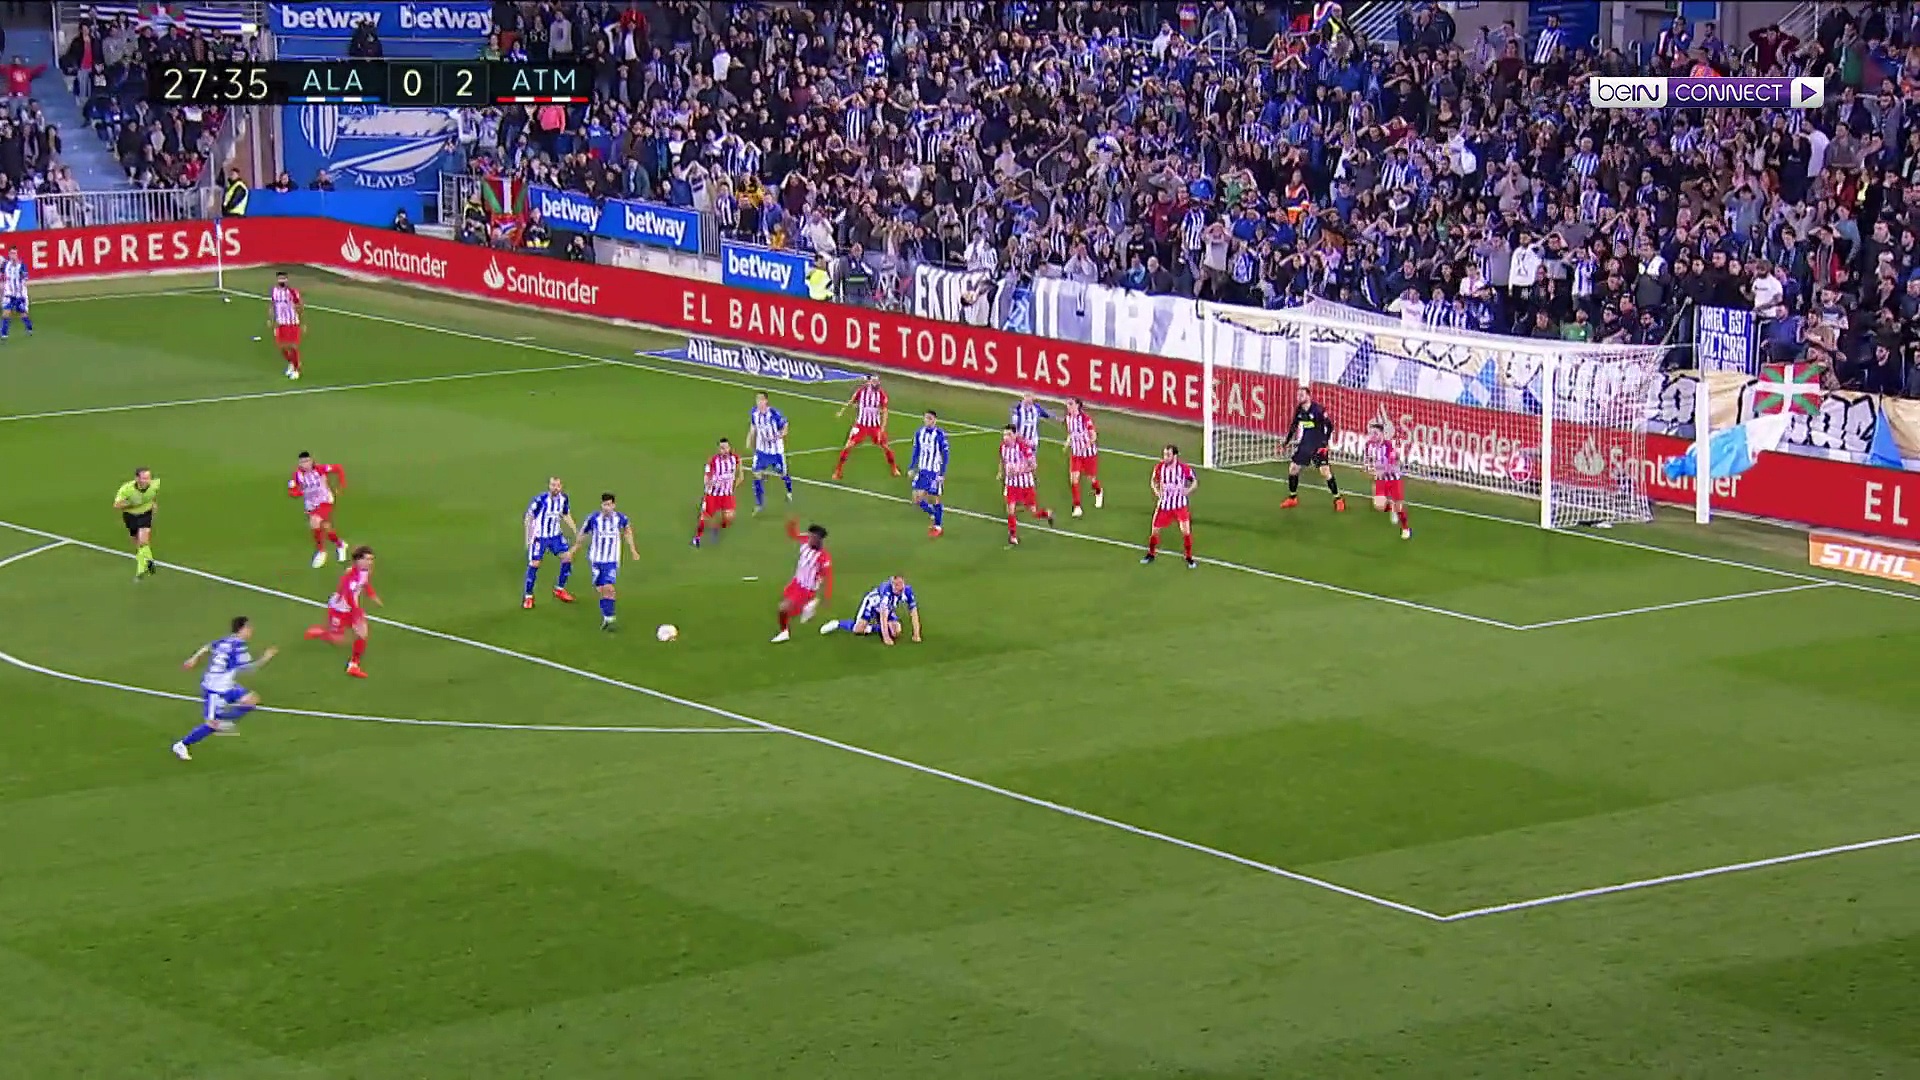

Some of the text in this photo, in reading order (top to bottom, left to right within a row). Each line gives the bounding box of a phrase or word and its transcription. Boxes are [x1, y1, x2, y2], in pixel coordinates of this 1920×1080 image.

[400, 5, 493, 35] betway
[355, 172, 416, 189] ALAVES
[541, 193, 599, 231] betway
[625, 205, 686, 246] betway
[32, 227, 242, 269] EMPRESAS
[363, 240, 448, 278] Santander
[506, 266, 599, 305] Santander
[728, 249, 792, 289] betway
[683, 290, 1266, 420] EL BANCO DE TODAS LAS EMPRESAS
[688, 339, 824, 381] Allianz Seguros
[1400, 413, 1521, 455] Santander
[1407, 441, 1507, 478] AIRLINES
[1864, 480, 1909, 526] EL
[1819, 543, 1914, 578] STIHL
